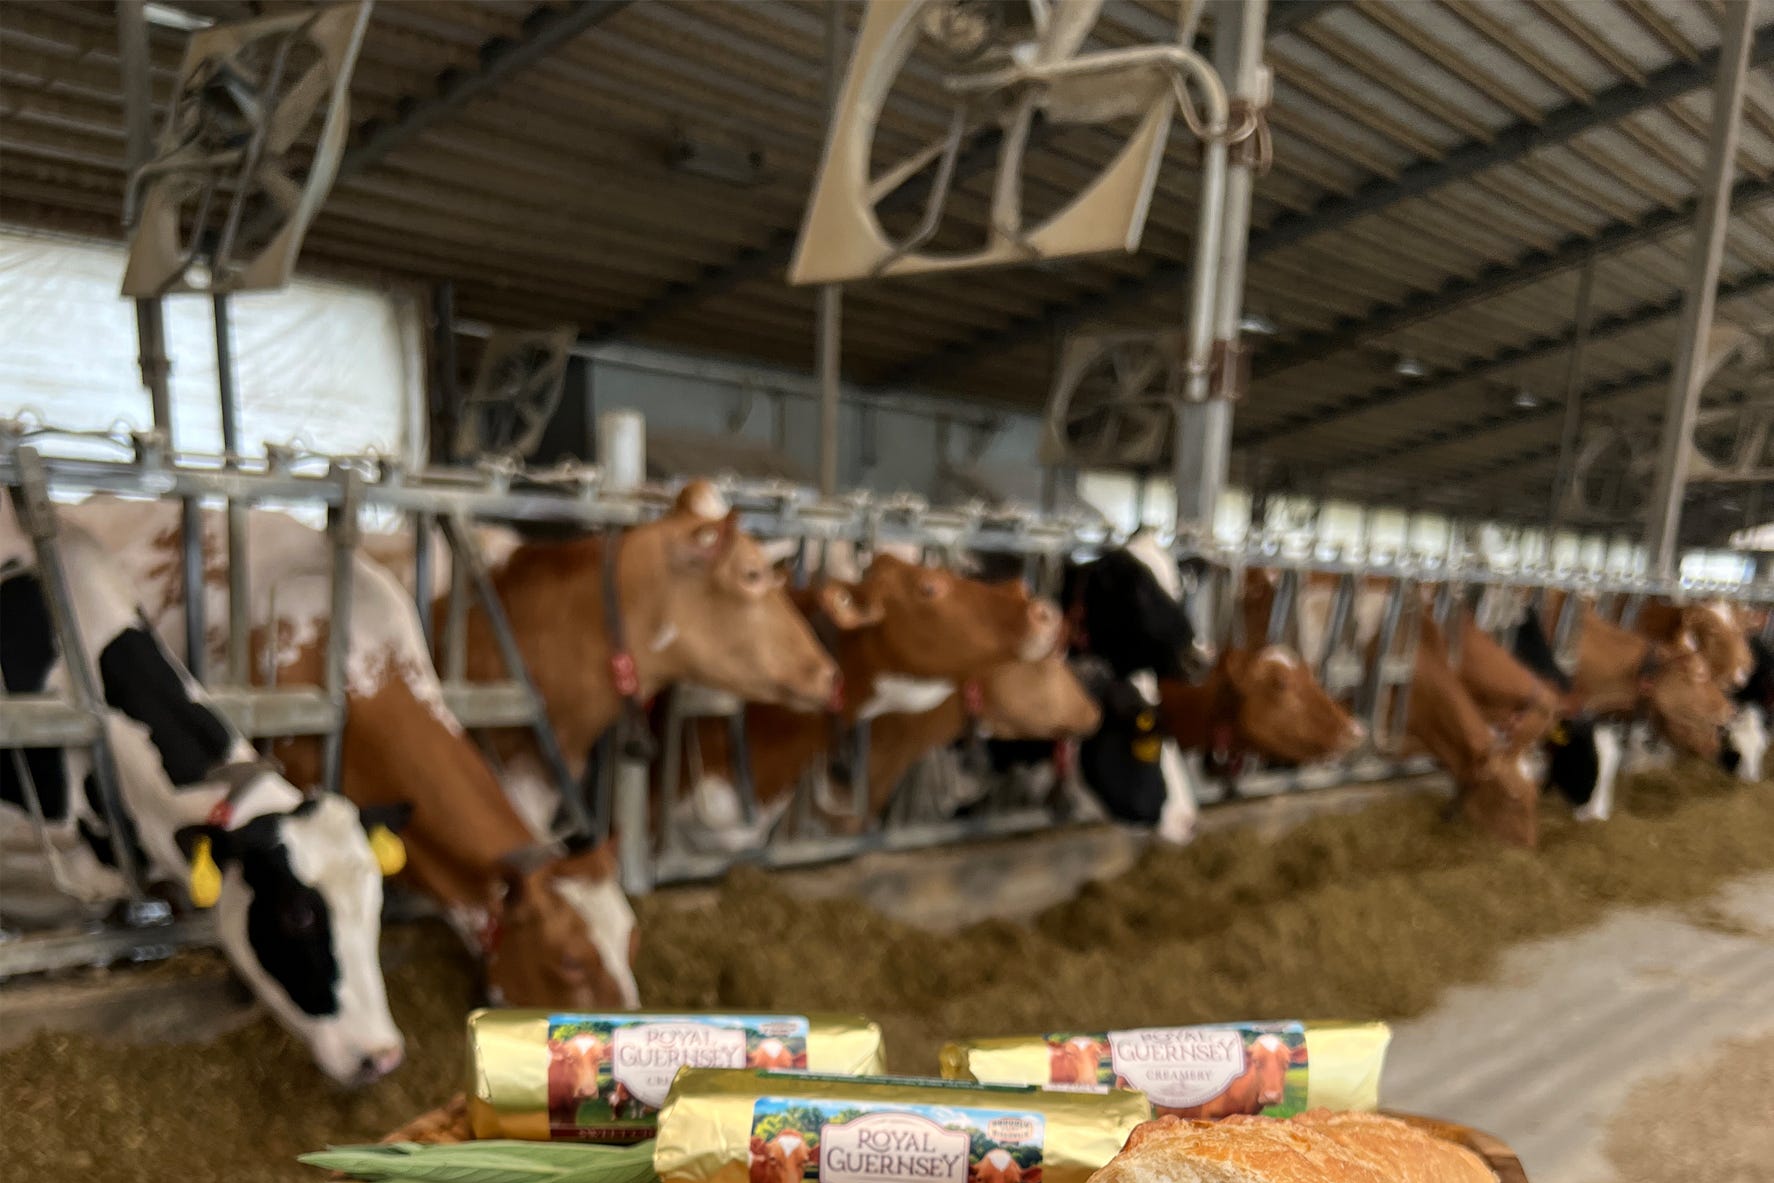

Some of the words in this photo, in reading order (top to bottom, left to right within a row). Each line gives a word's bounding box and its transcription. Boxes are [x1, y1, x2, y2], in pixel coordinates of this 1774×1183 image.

[647, 1028, 716, 1048] ROYAL
[620, 1045, 742, 1068] GUERNSEY
[1116, 1038, 1236, 1062] GUERNSEY
[1145, 1069, 1212, 1081] CREAMERY
[857, 1128, 936, 1154] ROYAL
[826, 1146, 963, 1179] GUERNSEY
